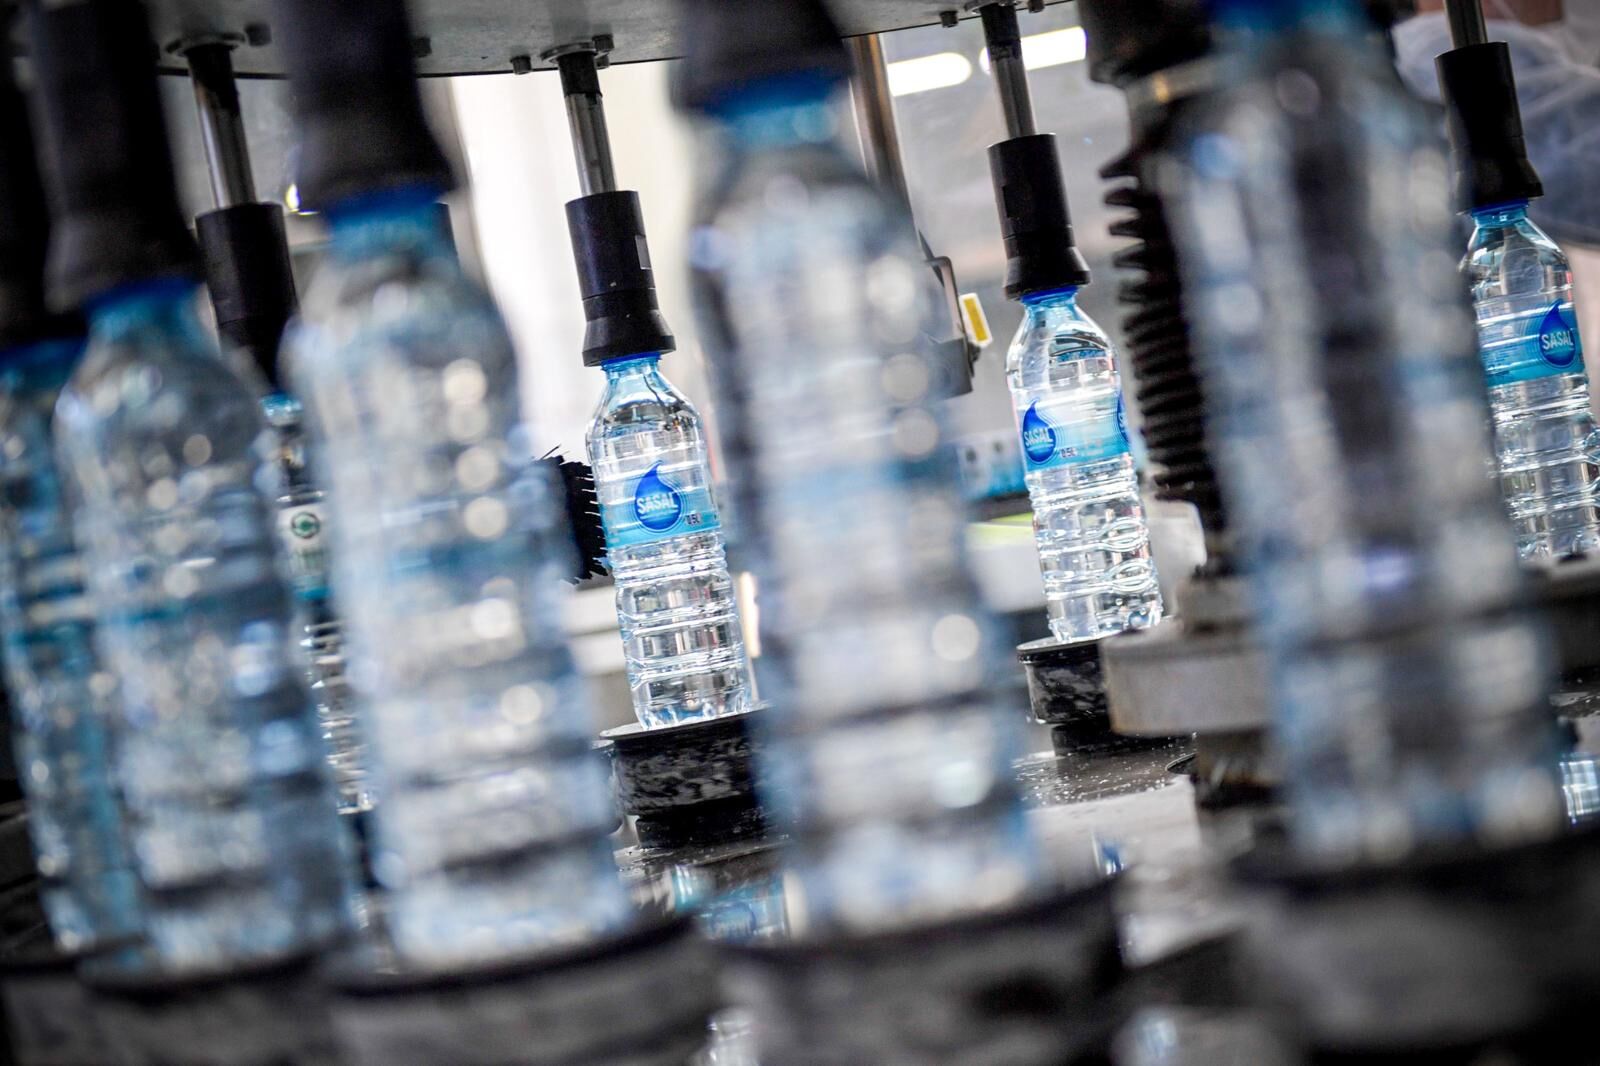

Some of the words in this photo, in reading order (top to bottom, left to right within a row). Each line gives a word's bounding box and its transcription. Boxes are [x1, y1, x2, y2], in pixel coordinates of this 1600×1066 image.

[1541, 329, 1574, 351] SASAL
[1023, 427, 1054, 448] SASAL
[636, 491, 679, 515] SASAL
